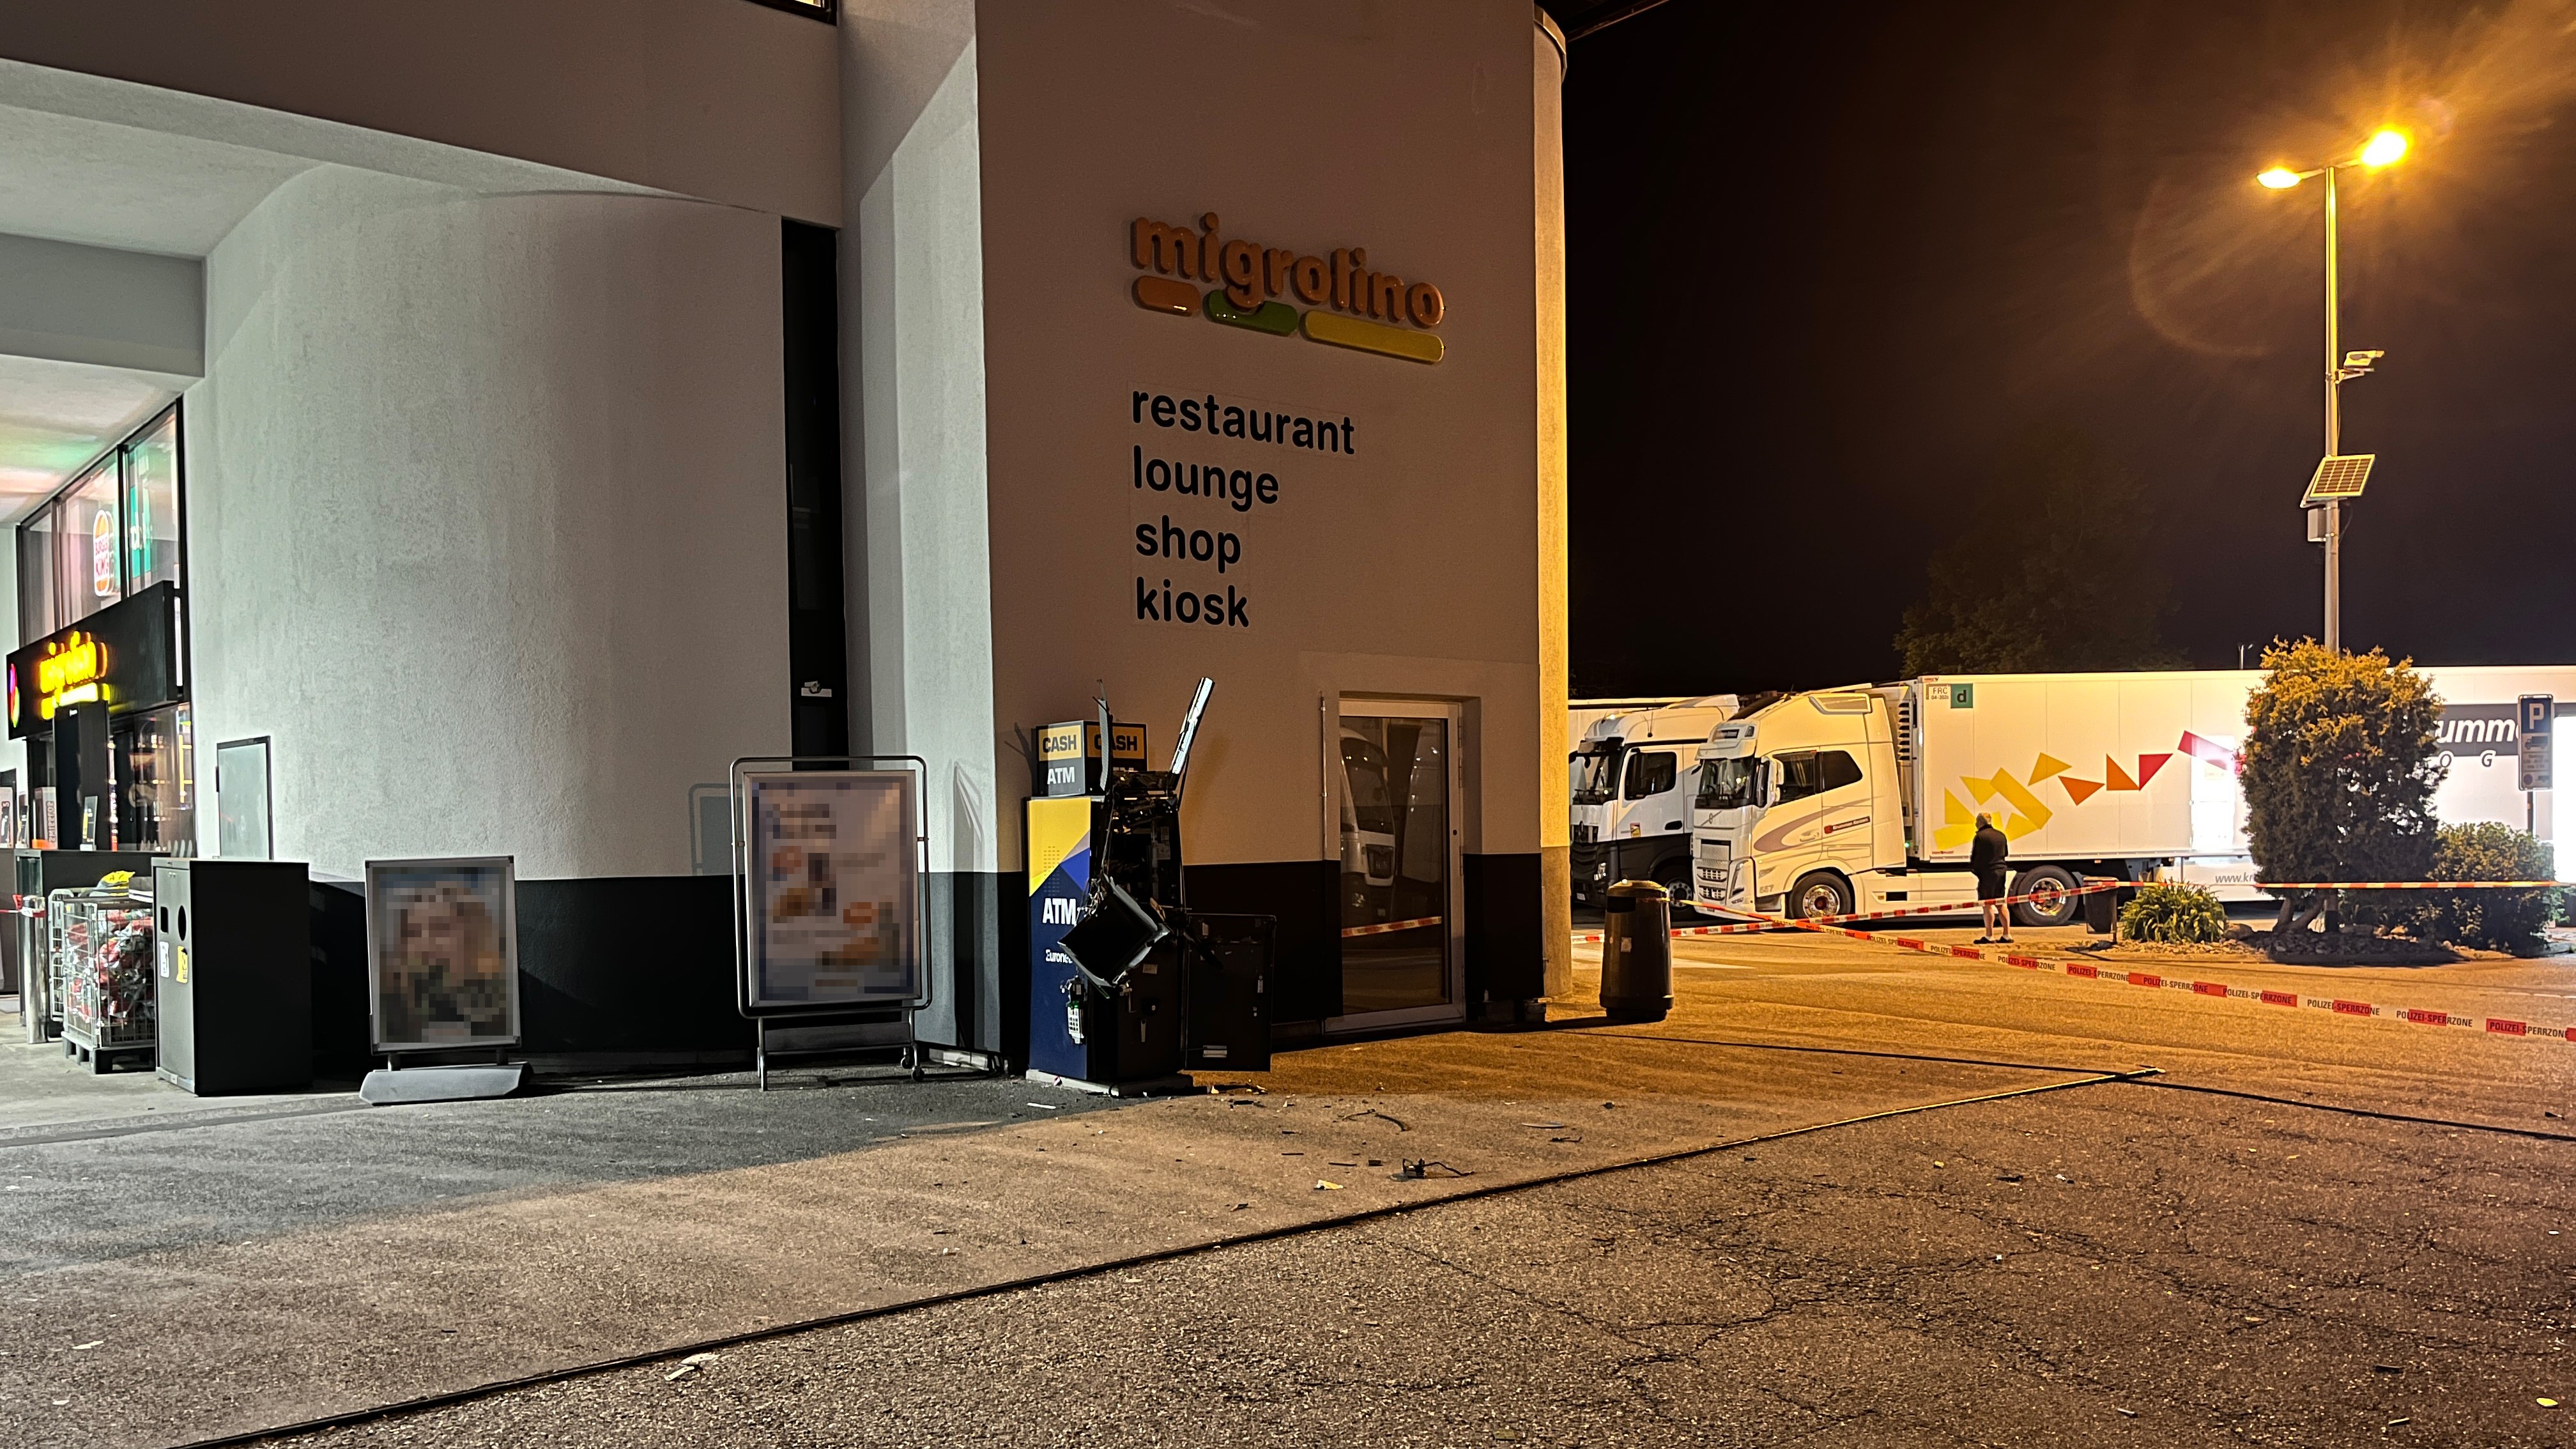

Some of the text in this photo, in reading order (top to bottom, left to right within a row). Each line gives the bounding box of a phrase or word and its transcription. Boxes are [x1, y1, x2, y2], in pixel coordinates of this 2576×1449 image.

[1131, 212, 1443, 326] migrolino
[1133, 390, 1354, 454] restaurant
[1133, 445, 1278, 512] lounge
[1135, 515, 1241, 573] shop
[1137, 576, 1249, 627] kiosk
[1957, 689, 1966, 703] d
[2529, 703, 2544, 730] P
[1043, 735, 1077, 753] CASH
[1094, 734, 1137, 751] CSH
[1047, 767, 1075, 785] ATM
[1042, 898, 1077, 924] ATM
[1998, 956, 2056, 970] POLIZEI-SPERRZONE
[2069, 966, 2129, 982] POLIZEI-SPERRZONE
[2143, 976, 2209, 994] POLIZEI-SPERRZONE
[2223, 988, 2292, 1004] POLIZEI-SPERRZONE
[2307, 999, 2380, 1016] POLIZEI-SPERRZONE
[2396, 1010, 2473, 1027] POLIZEI-SPERRZONE
[2490, 1022, 2569, 1039] POLIZEI-SPERRZONE
